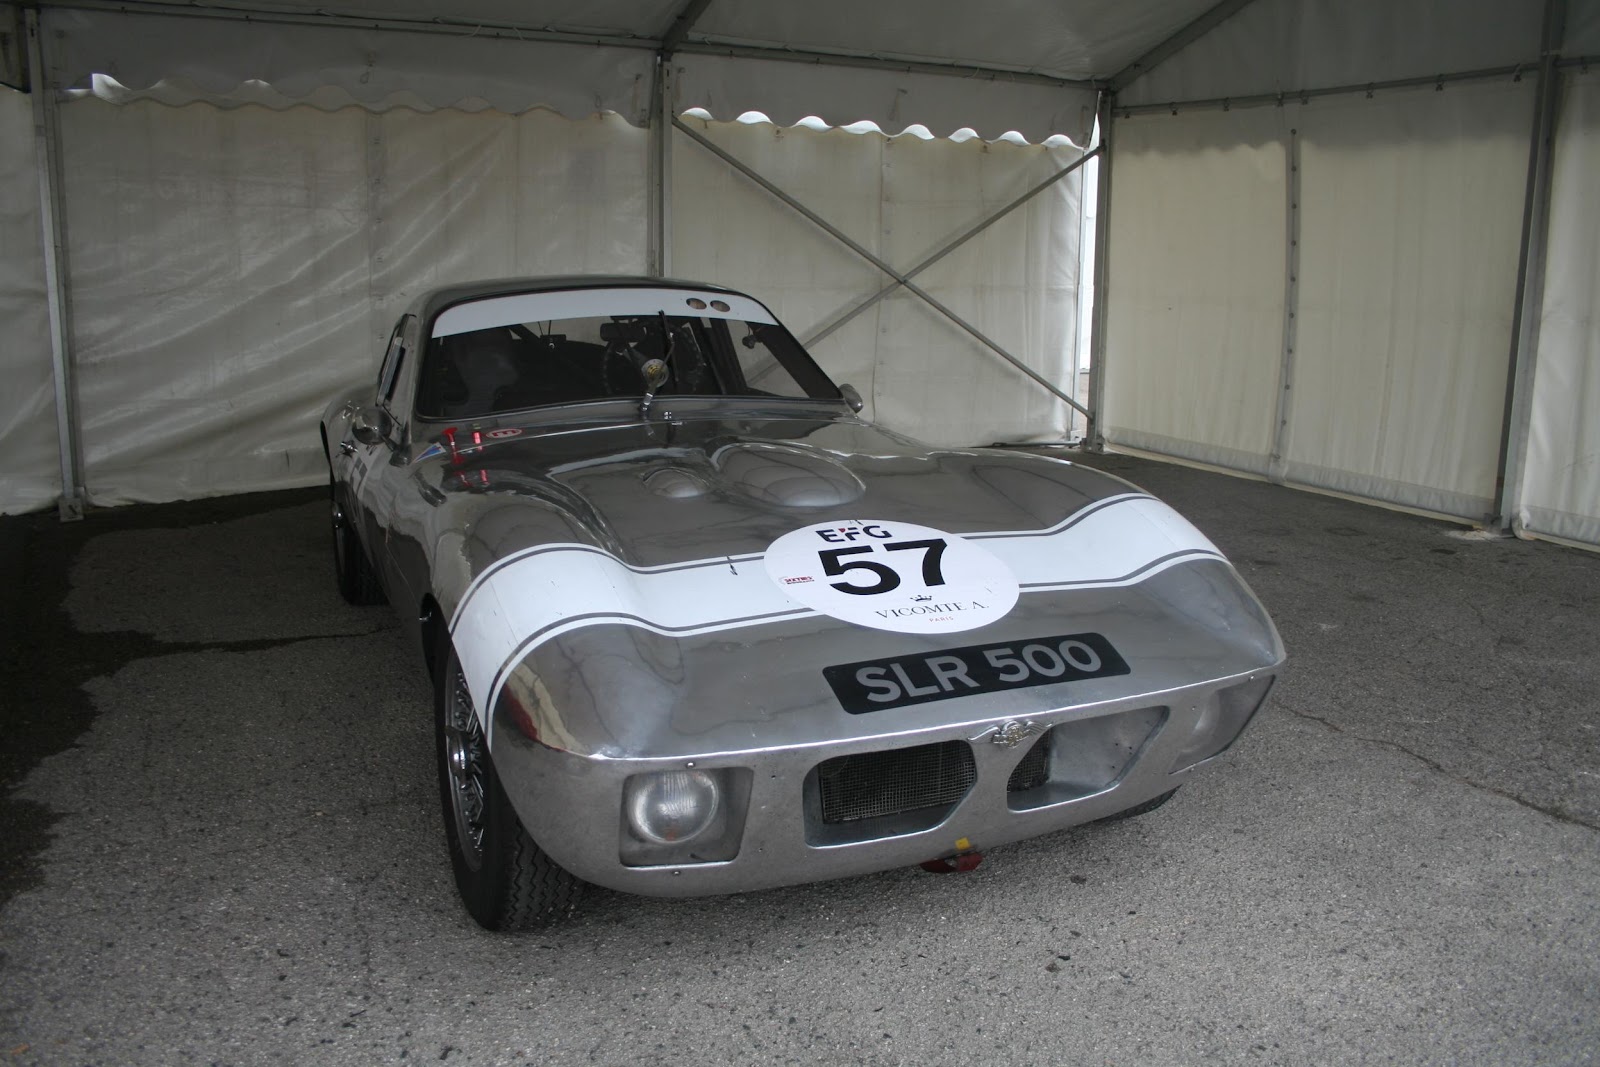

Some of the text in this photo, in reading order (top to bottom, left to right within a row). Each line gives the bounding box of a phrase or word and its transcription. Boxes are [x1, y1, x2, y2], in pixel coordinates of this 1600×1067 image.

[815, 525, 892, 542] EFG
[817, 538, 948, 595] 57
[874, 602, 967, 619] VICOMTE
[855, 639, 1102, 703] SLR 500
